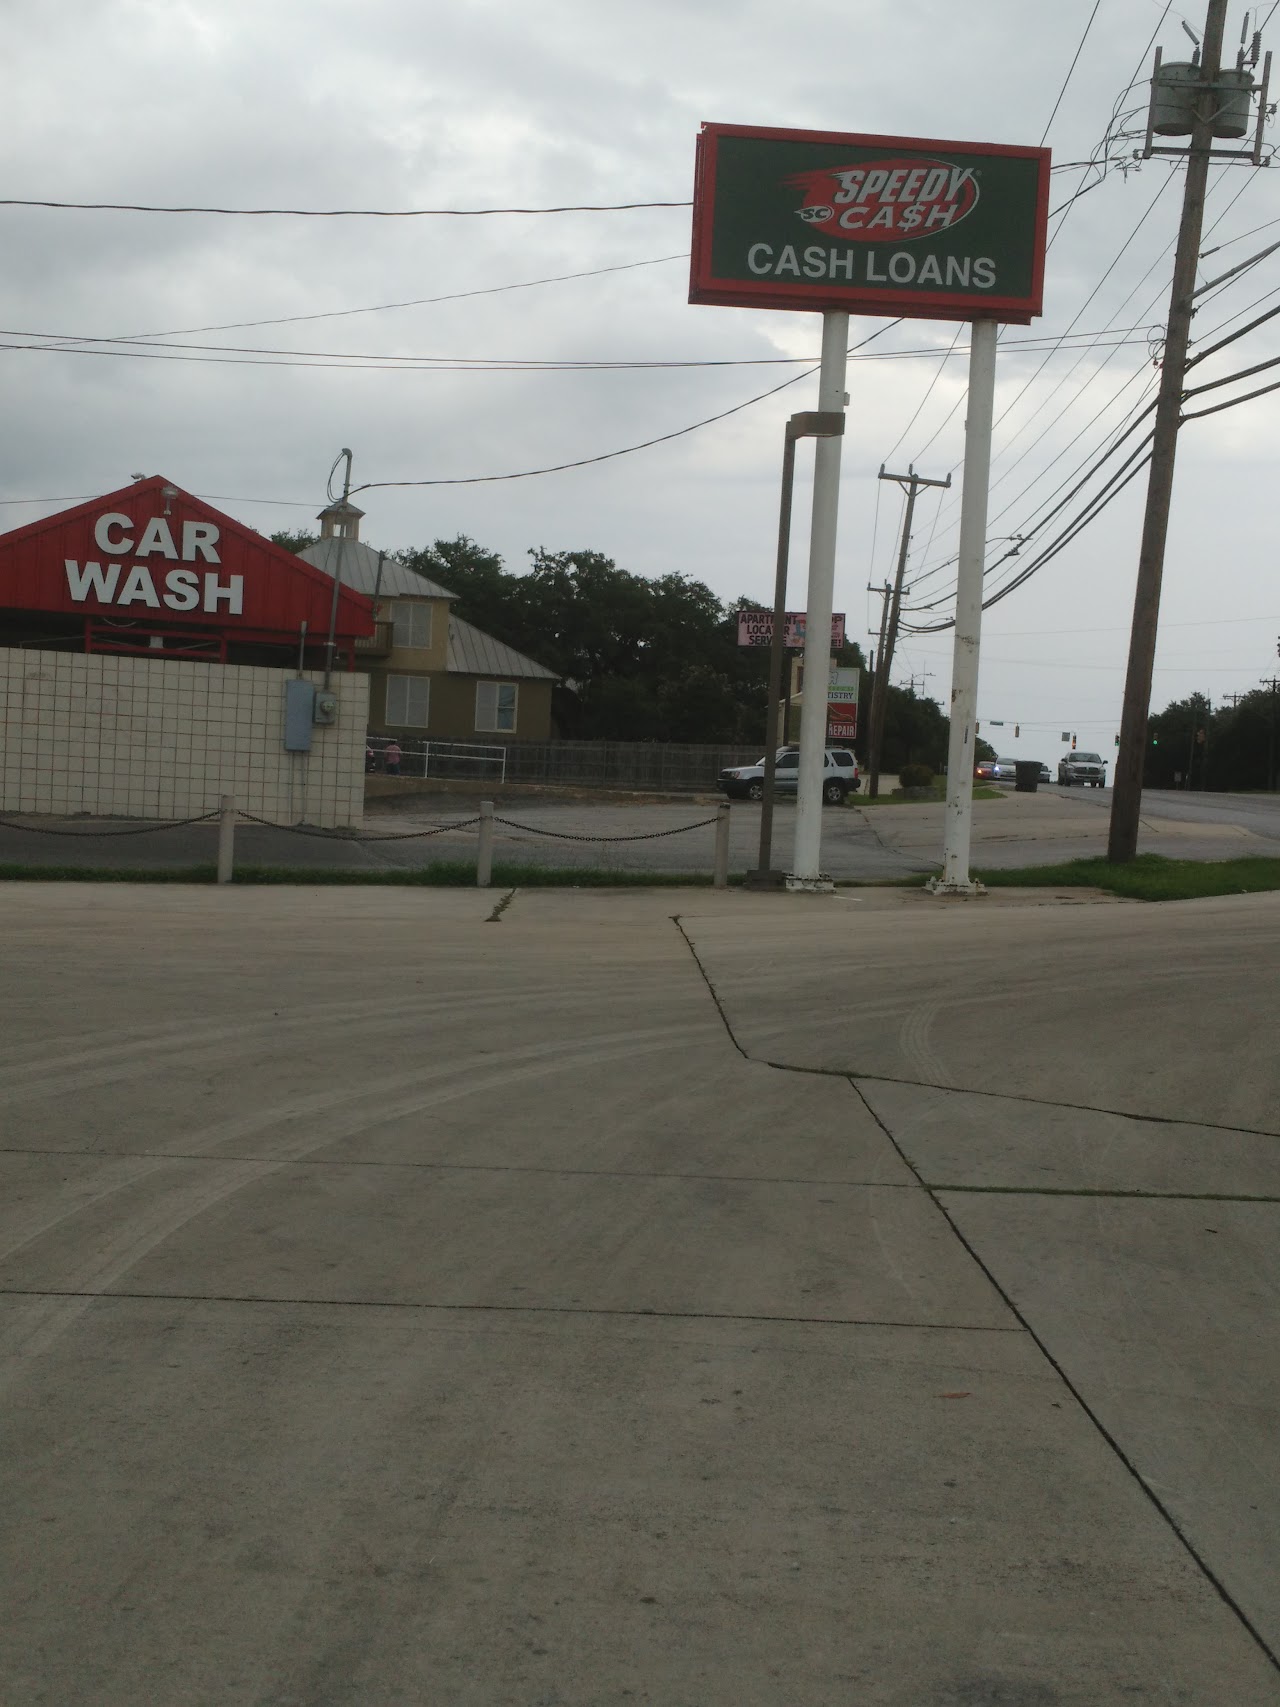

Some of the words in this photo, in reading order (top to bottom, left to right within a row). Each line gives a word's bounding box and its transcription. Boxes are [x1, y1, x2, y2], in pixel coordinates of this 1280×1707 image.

[832, 168, 975, 204] SPEEDY
[800, 208, 829, 220] SC
[839, 202, 958, 232] CA$H
[747, 243, 854, 280] CASH
[866, 251, 997, 289] LOANS
[94, 512, 222, 564] CAR
[64, 559, 244, 615] WASH
[740, 614, 798, 625] APARTNT
[746, 624, 790, 635] LOCAR
[748, 635, 787, 646] SERVE
[828, 723, 855, 737] REPAIR
